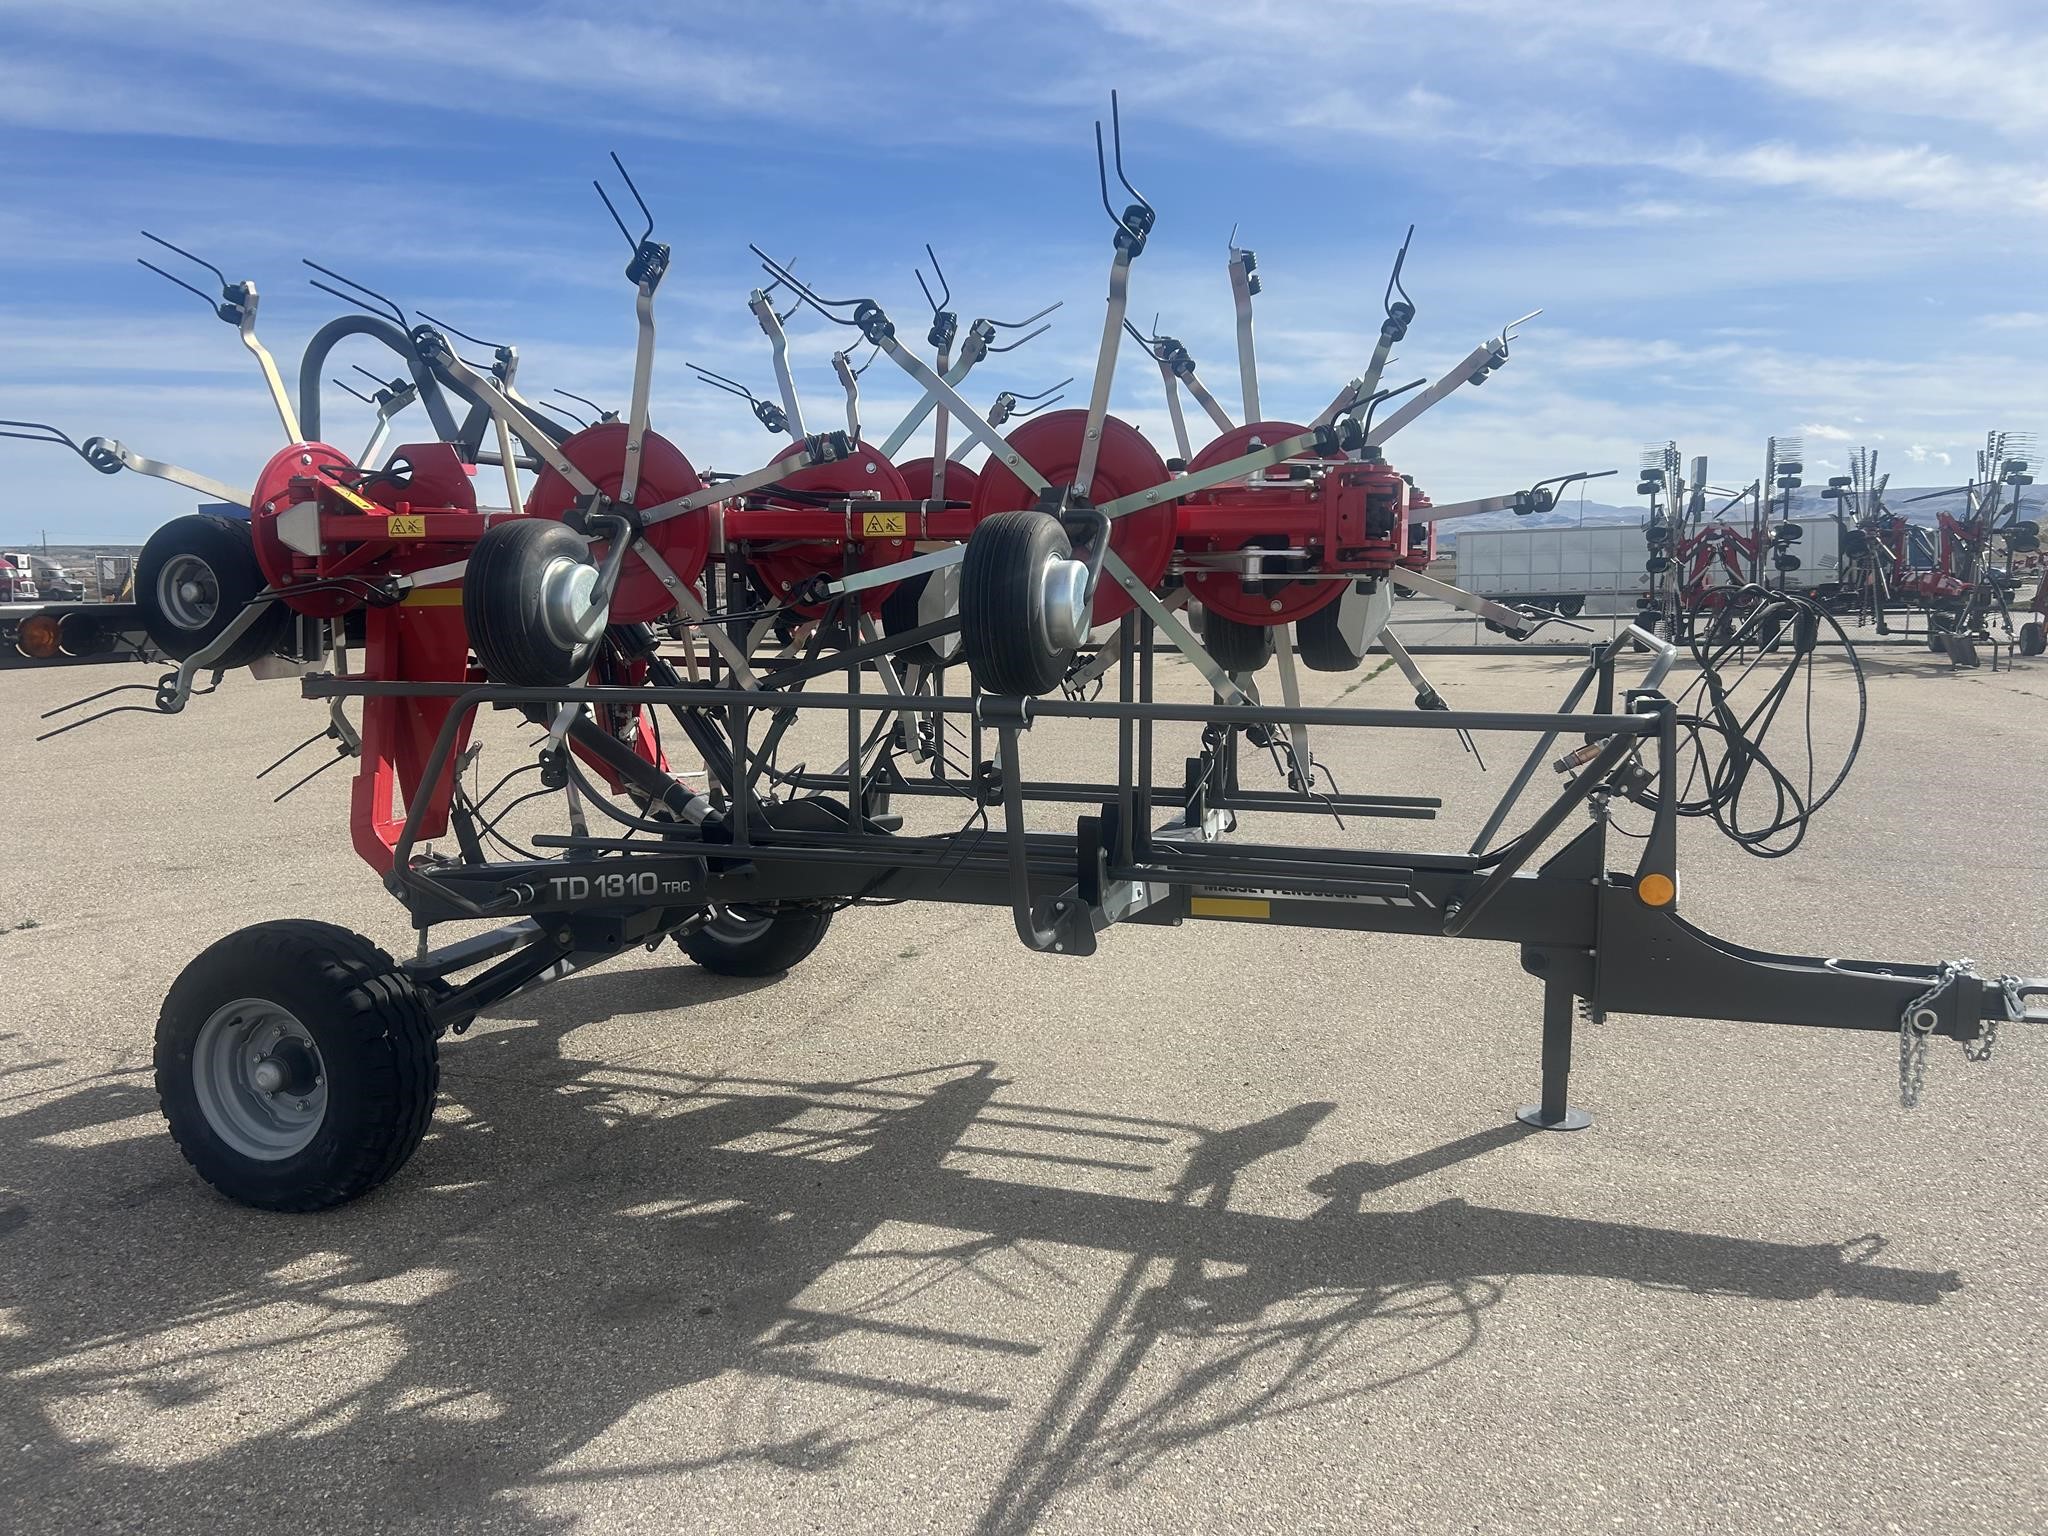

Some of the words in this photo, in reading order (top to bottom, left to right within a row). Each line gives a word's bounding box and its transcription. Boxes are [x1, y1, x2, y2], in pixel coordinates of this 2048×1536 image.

[550, 876, 589, 900] TD
[594, 872, 658, 898] 1310
[662, 880, 691, 894] TRC
